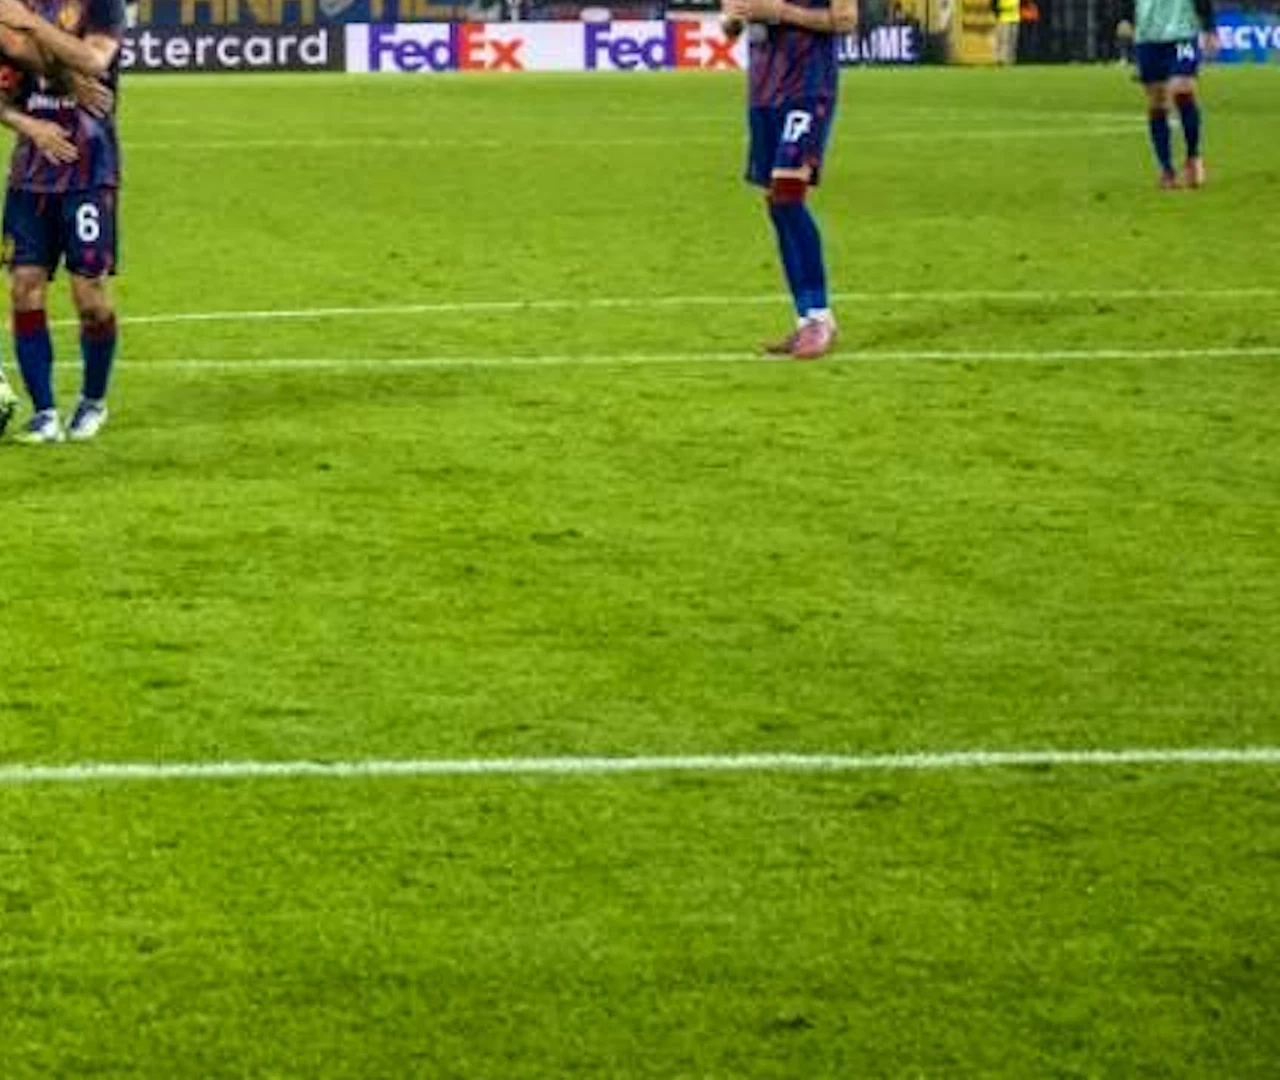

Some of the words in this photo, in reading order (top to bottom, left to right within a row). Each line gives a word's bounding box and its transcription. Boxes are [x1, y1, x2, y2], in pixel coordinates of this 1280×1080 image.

[368, 22, 525, 72] FedEx
[583, 21, 740, 72] FedEx
[75, 201, 101, 243] 6
